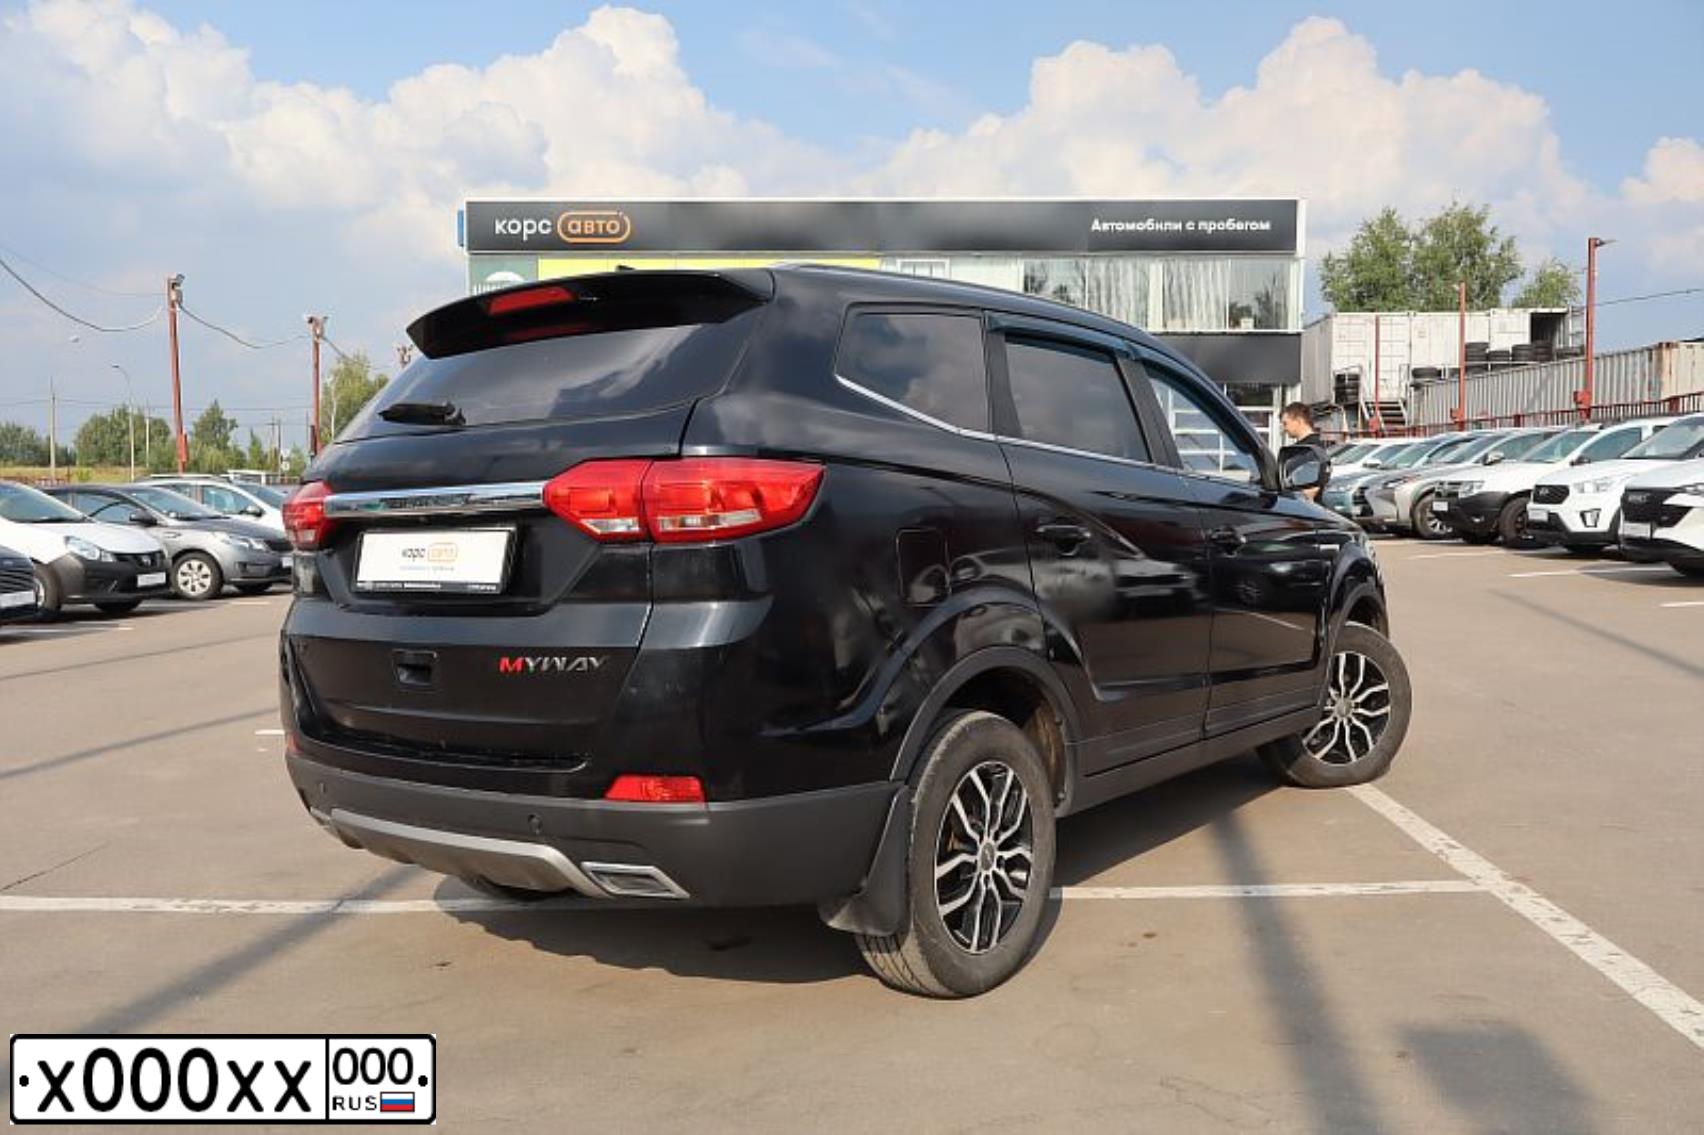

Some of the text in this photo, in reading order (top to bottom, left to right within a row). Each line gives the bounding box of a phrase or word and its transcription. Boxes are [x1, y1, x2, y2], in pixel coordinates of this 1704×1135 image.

[494, 218, 620, 241] корс авто
[1091, 218, 1272, 234] Автомобили с пробегом
[499, 656, 610, 673] MYWAY
